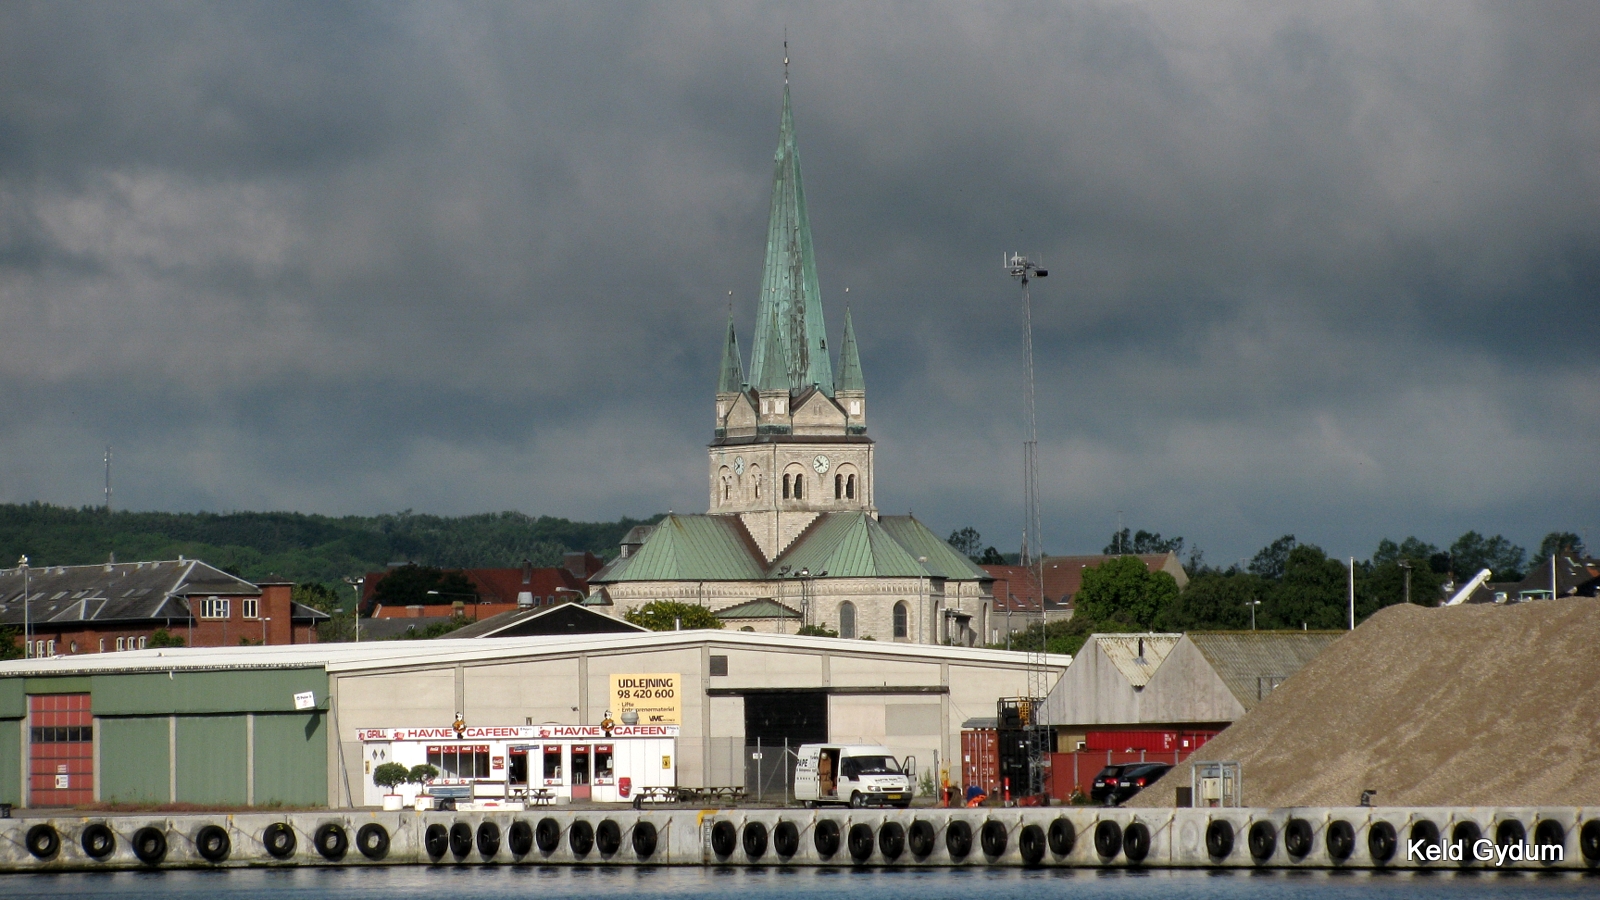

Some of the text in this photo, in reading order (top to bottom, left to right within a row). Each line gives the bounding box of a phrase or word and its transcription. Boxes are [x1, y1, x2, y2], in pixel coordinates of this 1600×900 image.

[618, 678, 673, 689] UDLEJNING
[618, 689, 674, 698] 98 420 600
[366, 729, 387, 738] GRILL
[408, 729, 452, 738] HAVNE
[466, 728, 518, 737] CAFEEN
[554, 727, 600, 736] HAVNE
[614, 726, 666, 735] CAFEEN
